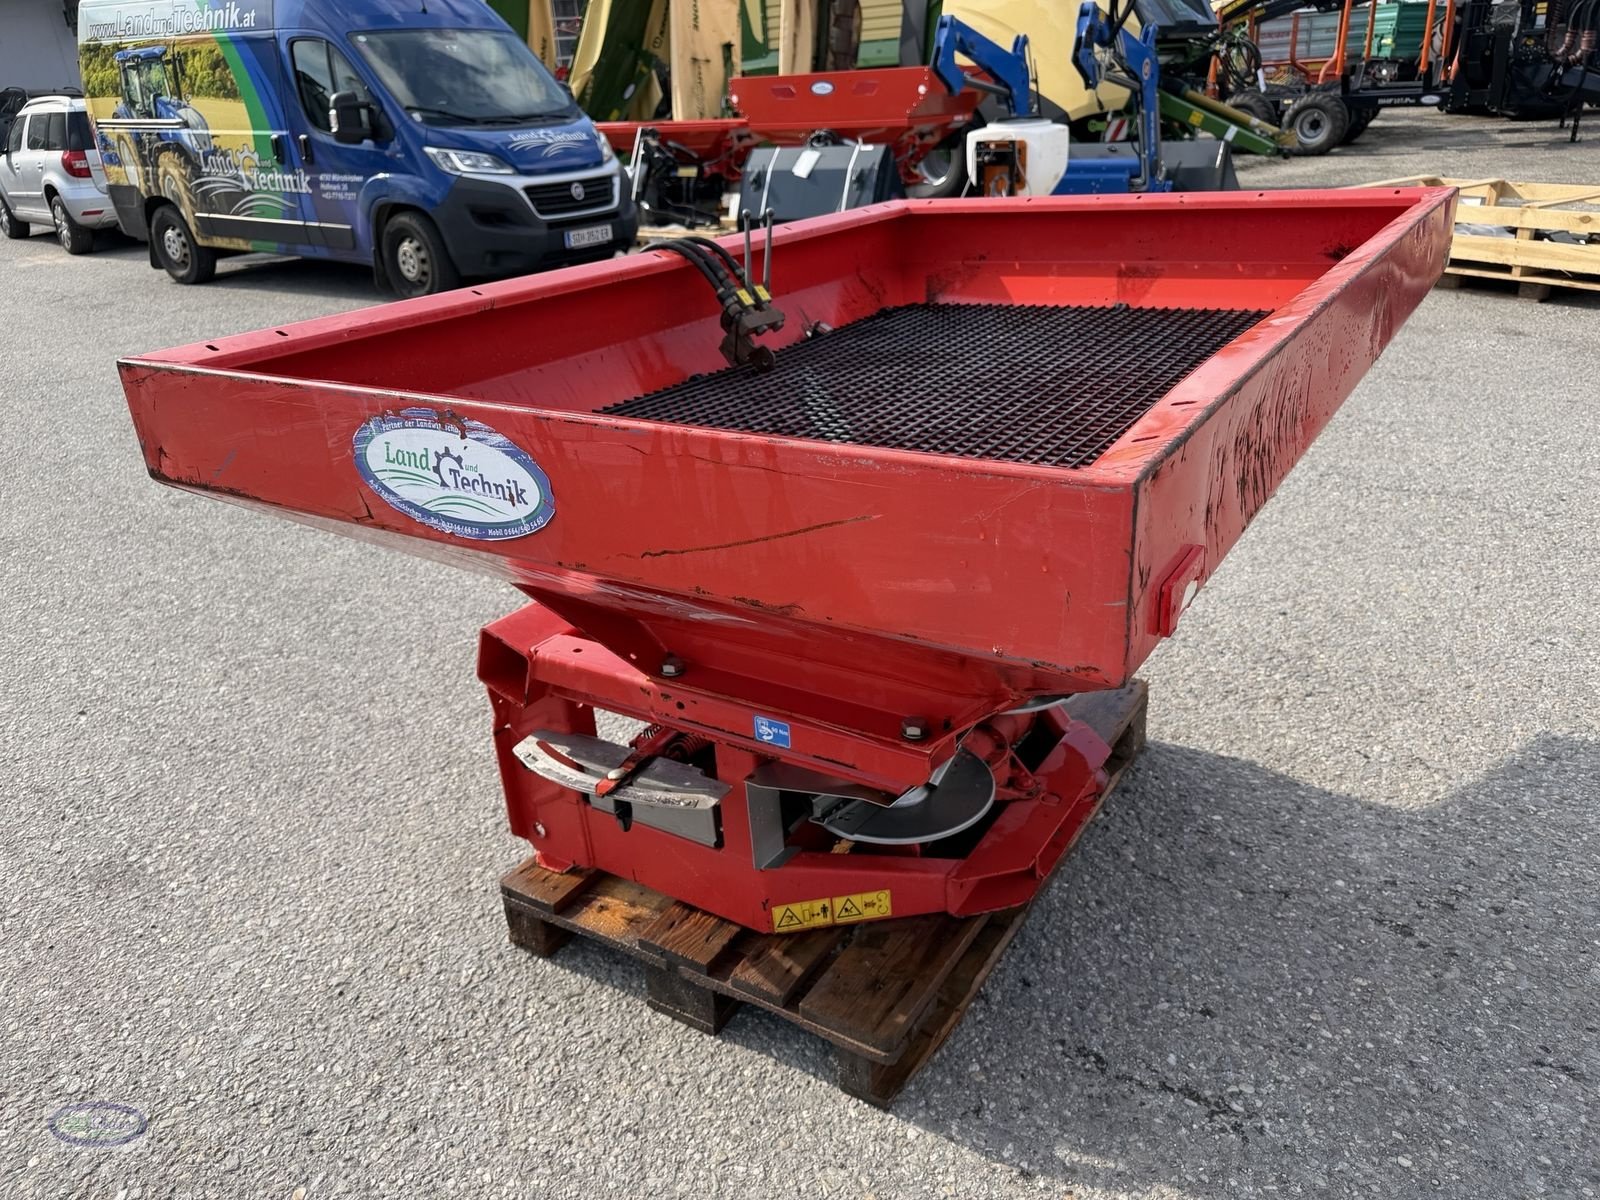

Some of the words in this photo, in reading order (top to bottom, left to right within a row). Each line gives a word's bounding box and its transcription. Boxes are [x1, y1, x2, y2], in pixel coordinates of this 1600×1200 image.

[88, 2, 256, 38] www.LandundTechnik.at
[200, 150, 238, 173] Land
[260, 159, 272, 168] und
[249, 167, 313, 194] Technik
[382, 422, 402, 431] Partner
[404, 420, 415, 428] der
[384, 441, 431, 471] Land
[464, 464, 479, 473] und
[449, 467, 529, 506] Technik
[488, 528, 503, 536] Mobil
